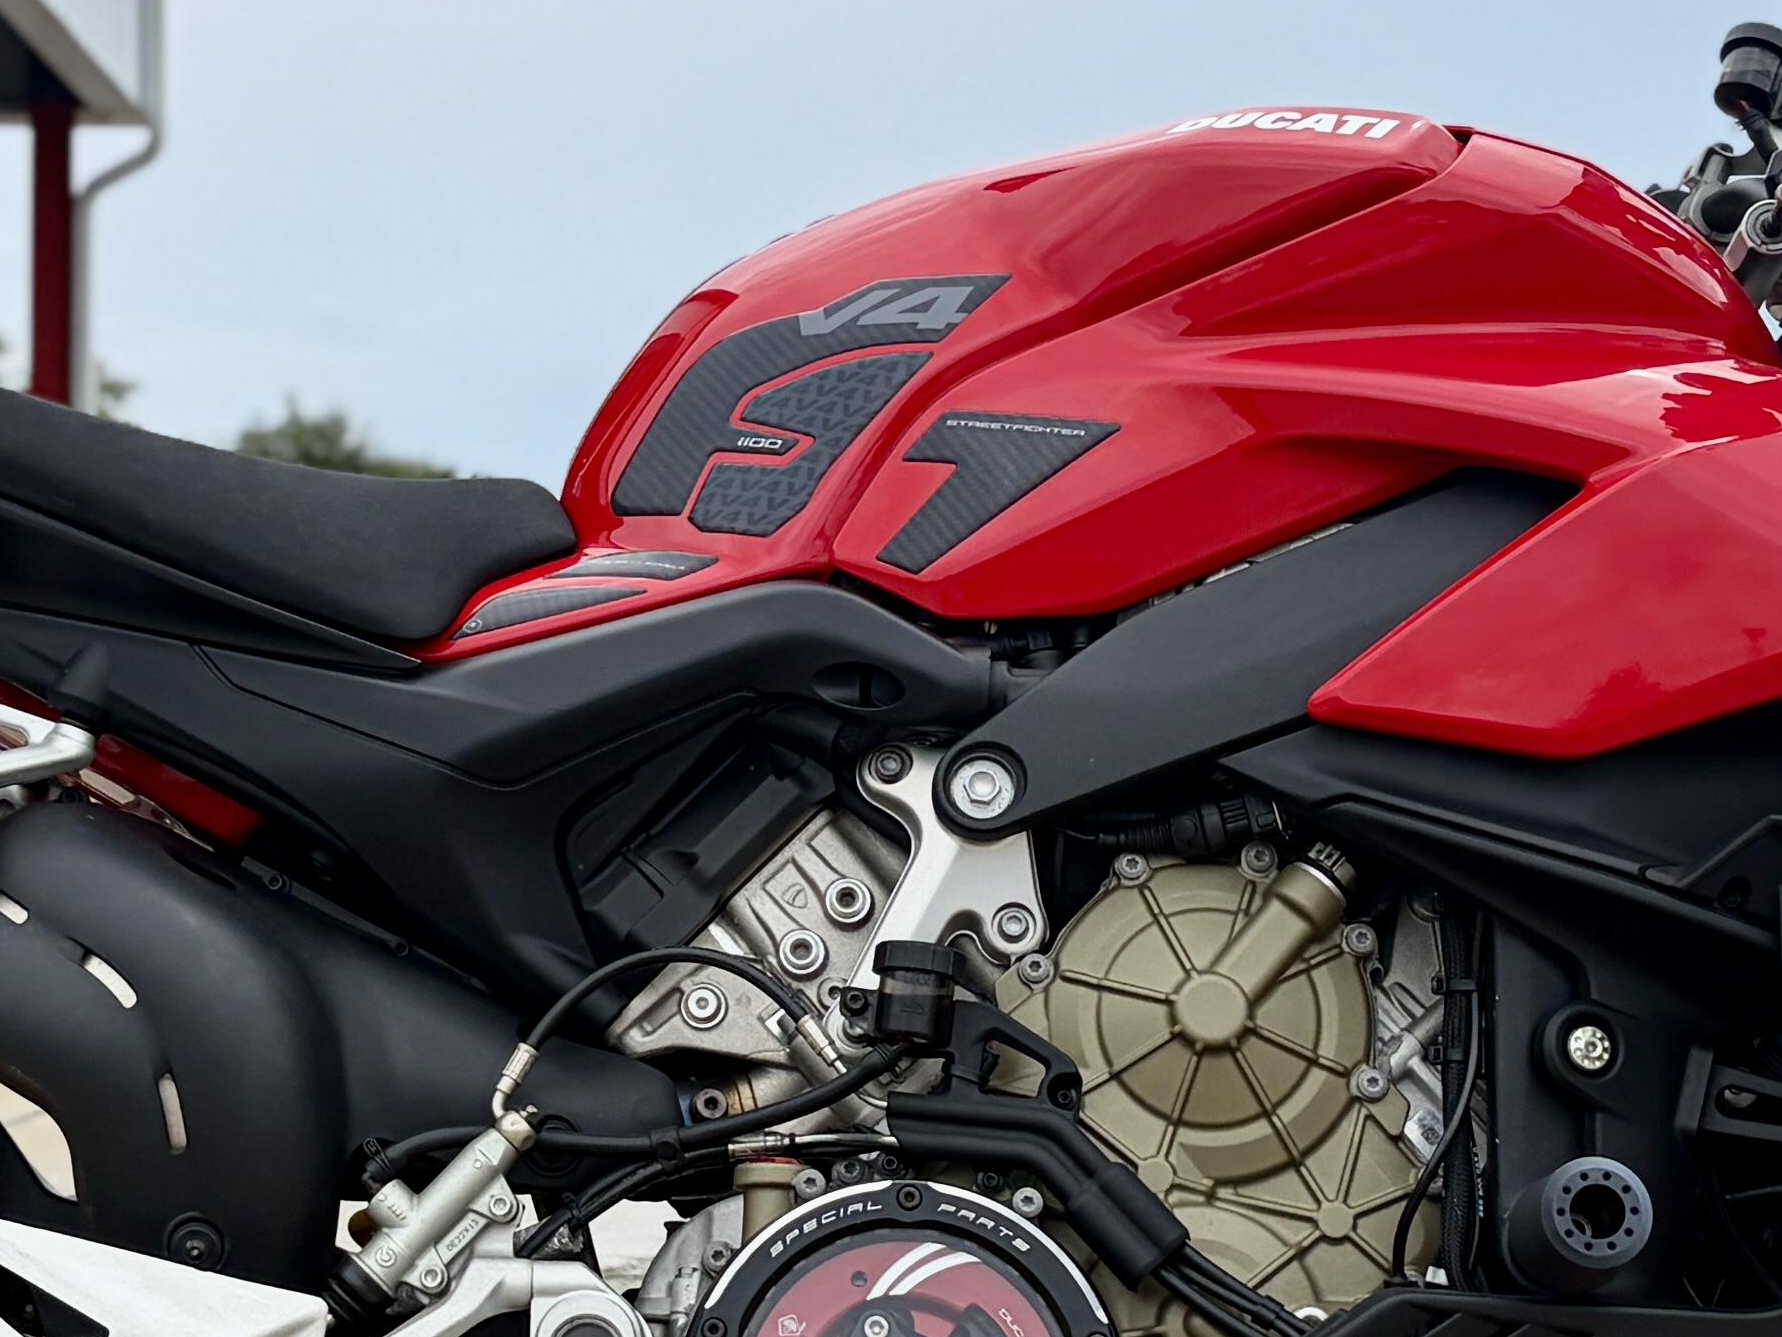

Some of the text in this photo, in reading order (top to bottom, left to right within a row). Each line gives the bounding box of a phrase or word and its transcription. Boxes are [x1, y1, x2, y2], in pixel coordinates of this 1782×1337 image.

[1166, 112, 1400, 139] DUCATI
[799, 286, 974, 336] V4
[946, 419, 1086, 436] STREETFIGHTER
[737, 437, 783, 449] 1100
[770, 1201, 1030, 1257] SPECIAL PARTS
